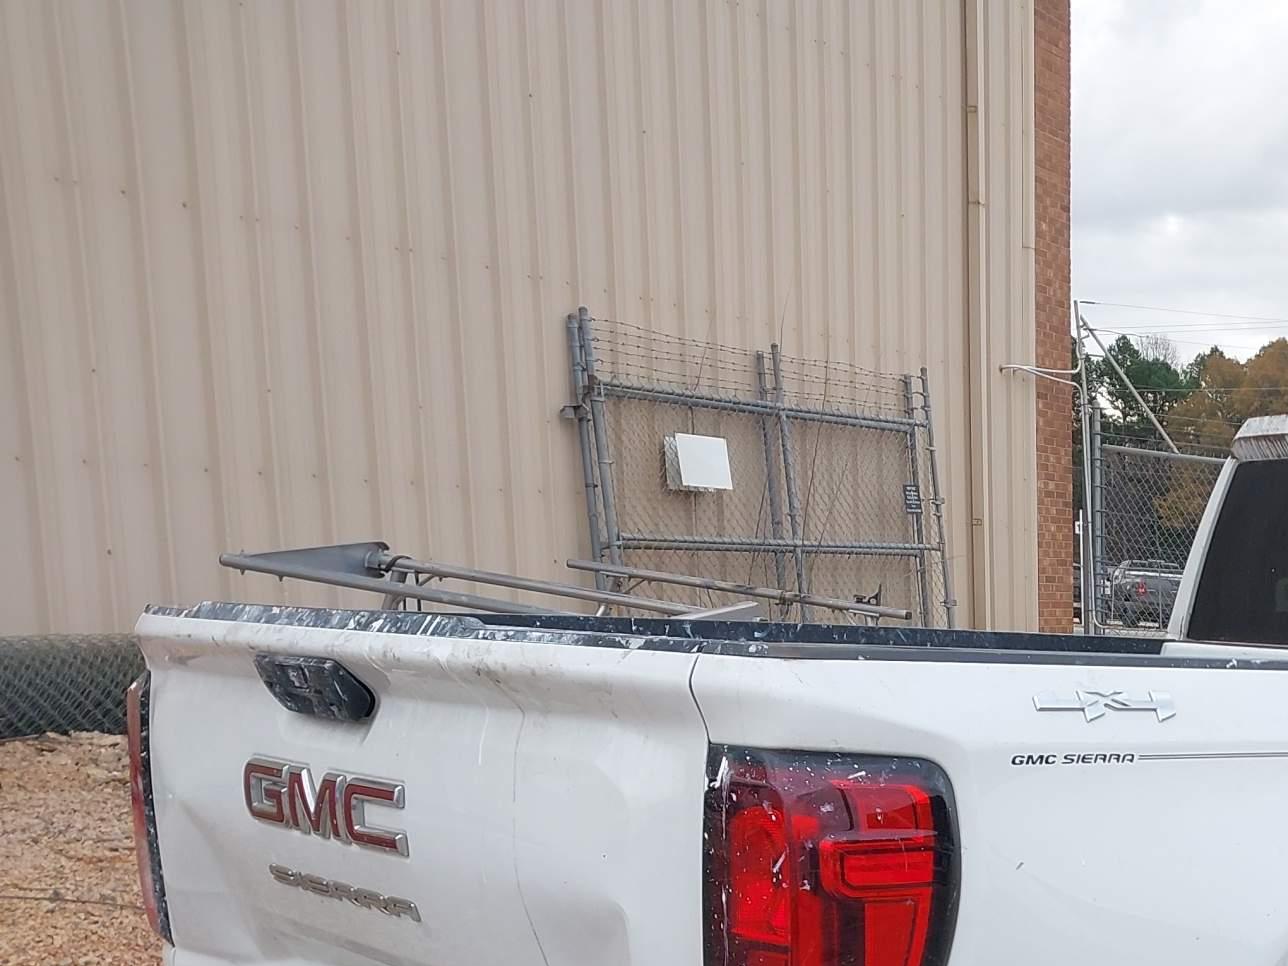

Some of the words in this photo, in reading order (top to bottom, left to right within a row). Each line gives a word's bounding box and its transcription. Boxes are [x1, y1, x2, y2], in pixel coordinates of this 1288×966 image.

[1010, 754, 1057, 766] GMC
[1061, 753, 1135, 765] SIERRA
[243, 755, 411, 859] GMC
[269, 862, 422, 923] SIERRA
